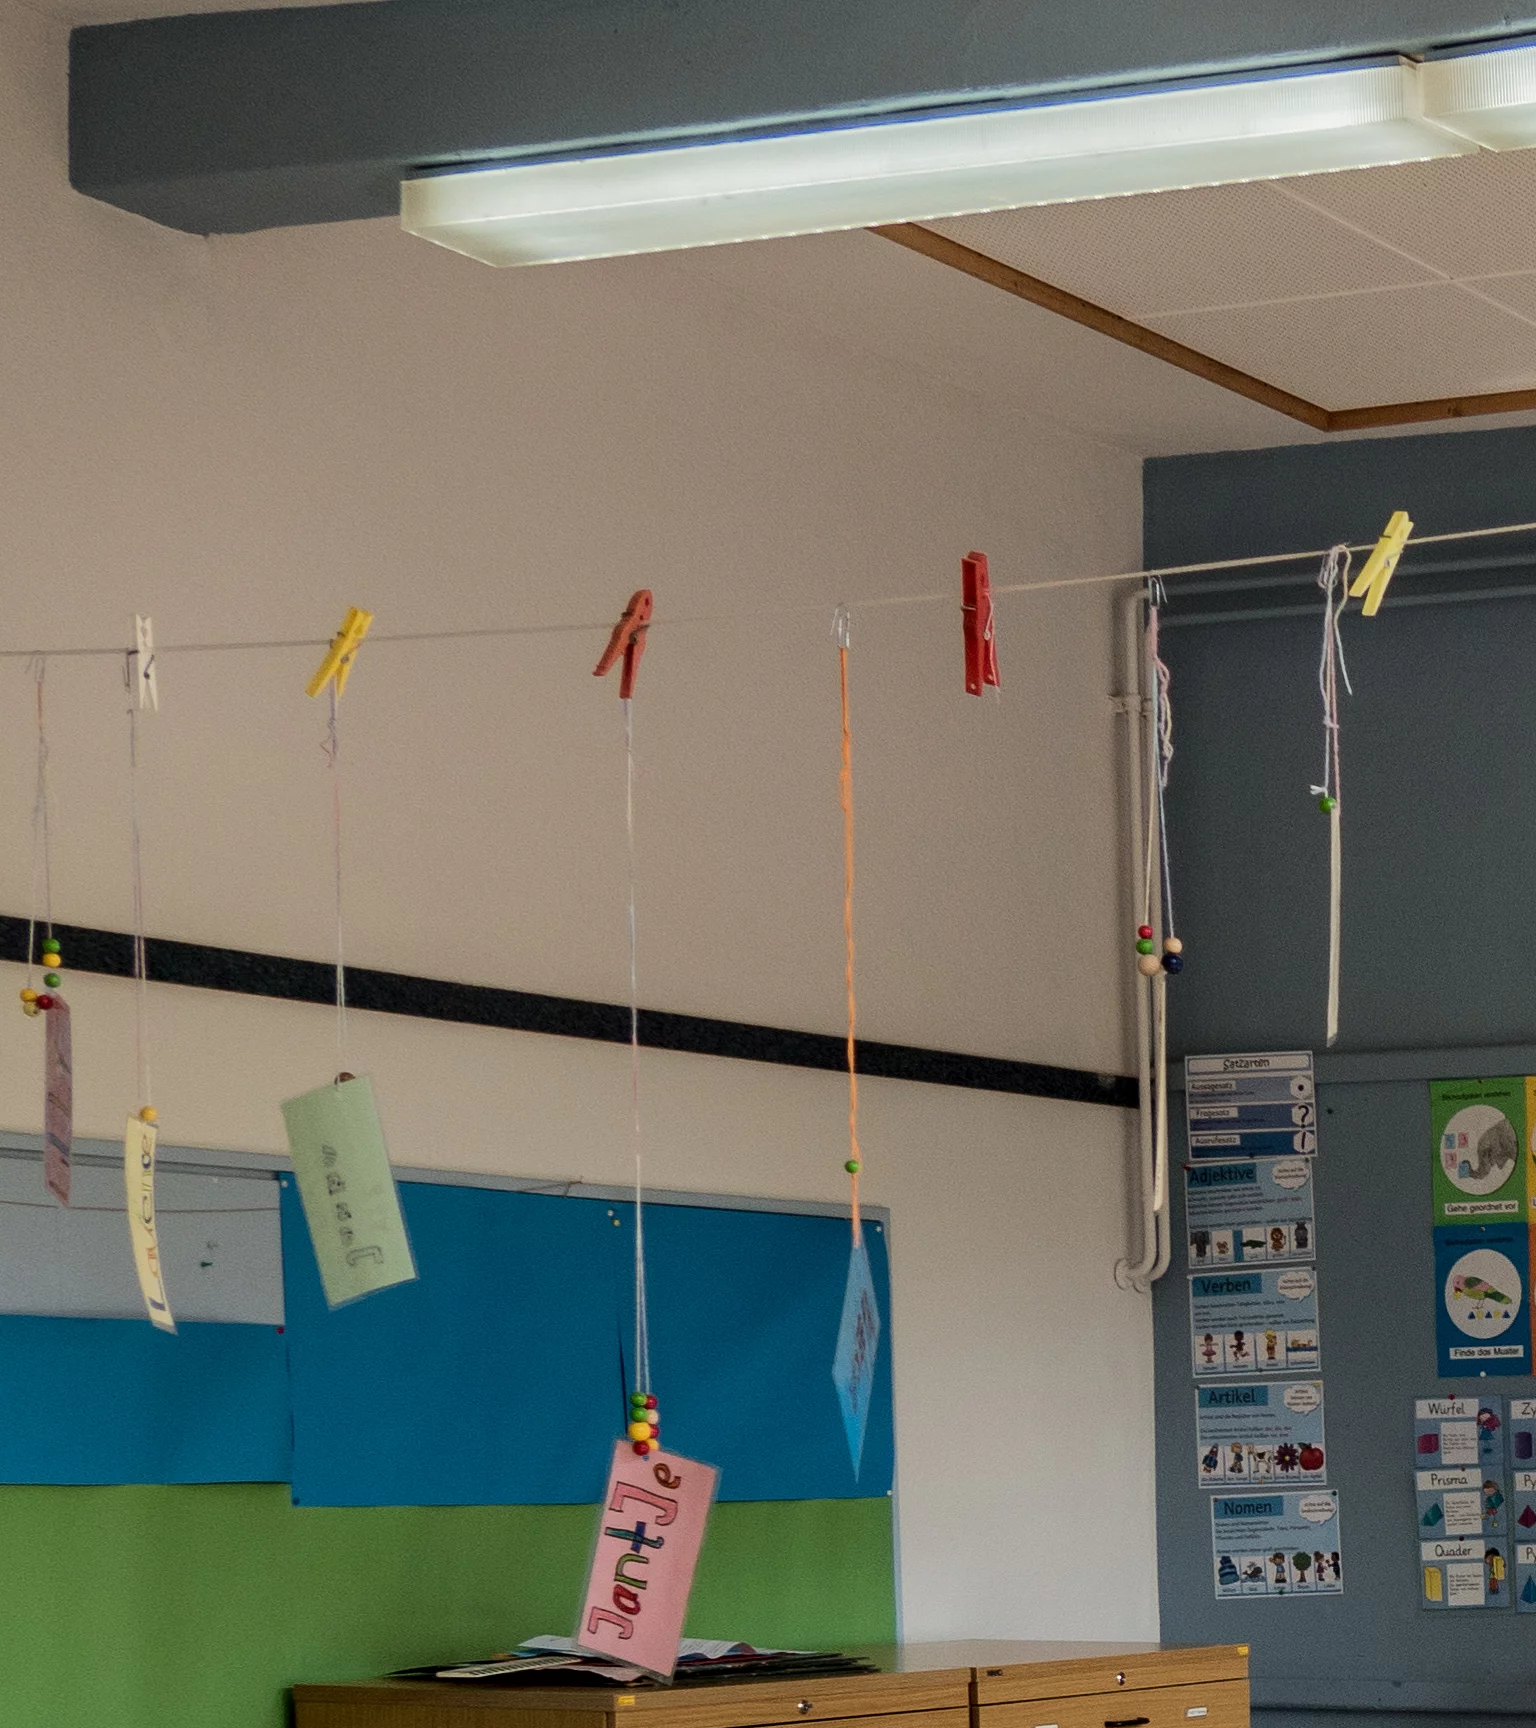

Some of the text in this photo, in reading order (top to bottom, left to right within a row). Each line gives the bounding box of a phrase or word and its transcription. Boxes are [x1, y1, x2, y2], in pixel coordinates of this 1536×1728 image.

[1190, 1167, 1254, 1186] Adjektive
[1446, 1203, 1517, 1214] Gehe geordnet vor
[1202, 1278, 1252, 1293] Verben
[1454, 1346, 1520, 1358] Finde das Muster
[1208, 1389, 1256, 1404] Artikel
[1430, 1472, 1469, 1486] Prisma
[1224, 1501, 1272, 1515] Nomen
[1434, 1545, 1473, 1557] Quader
